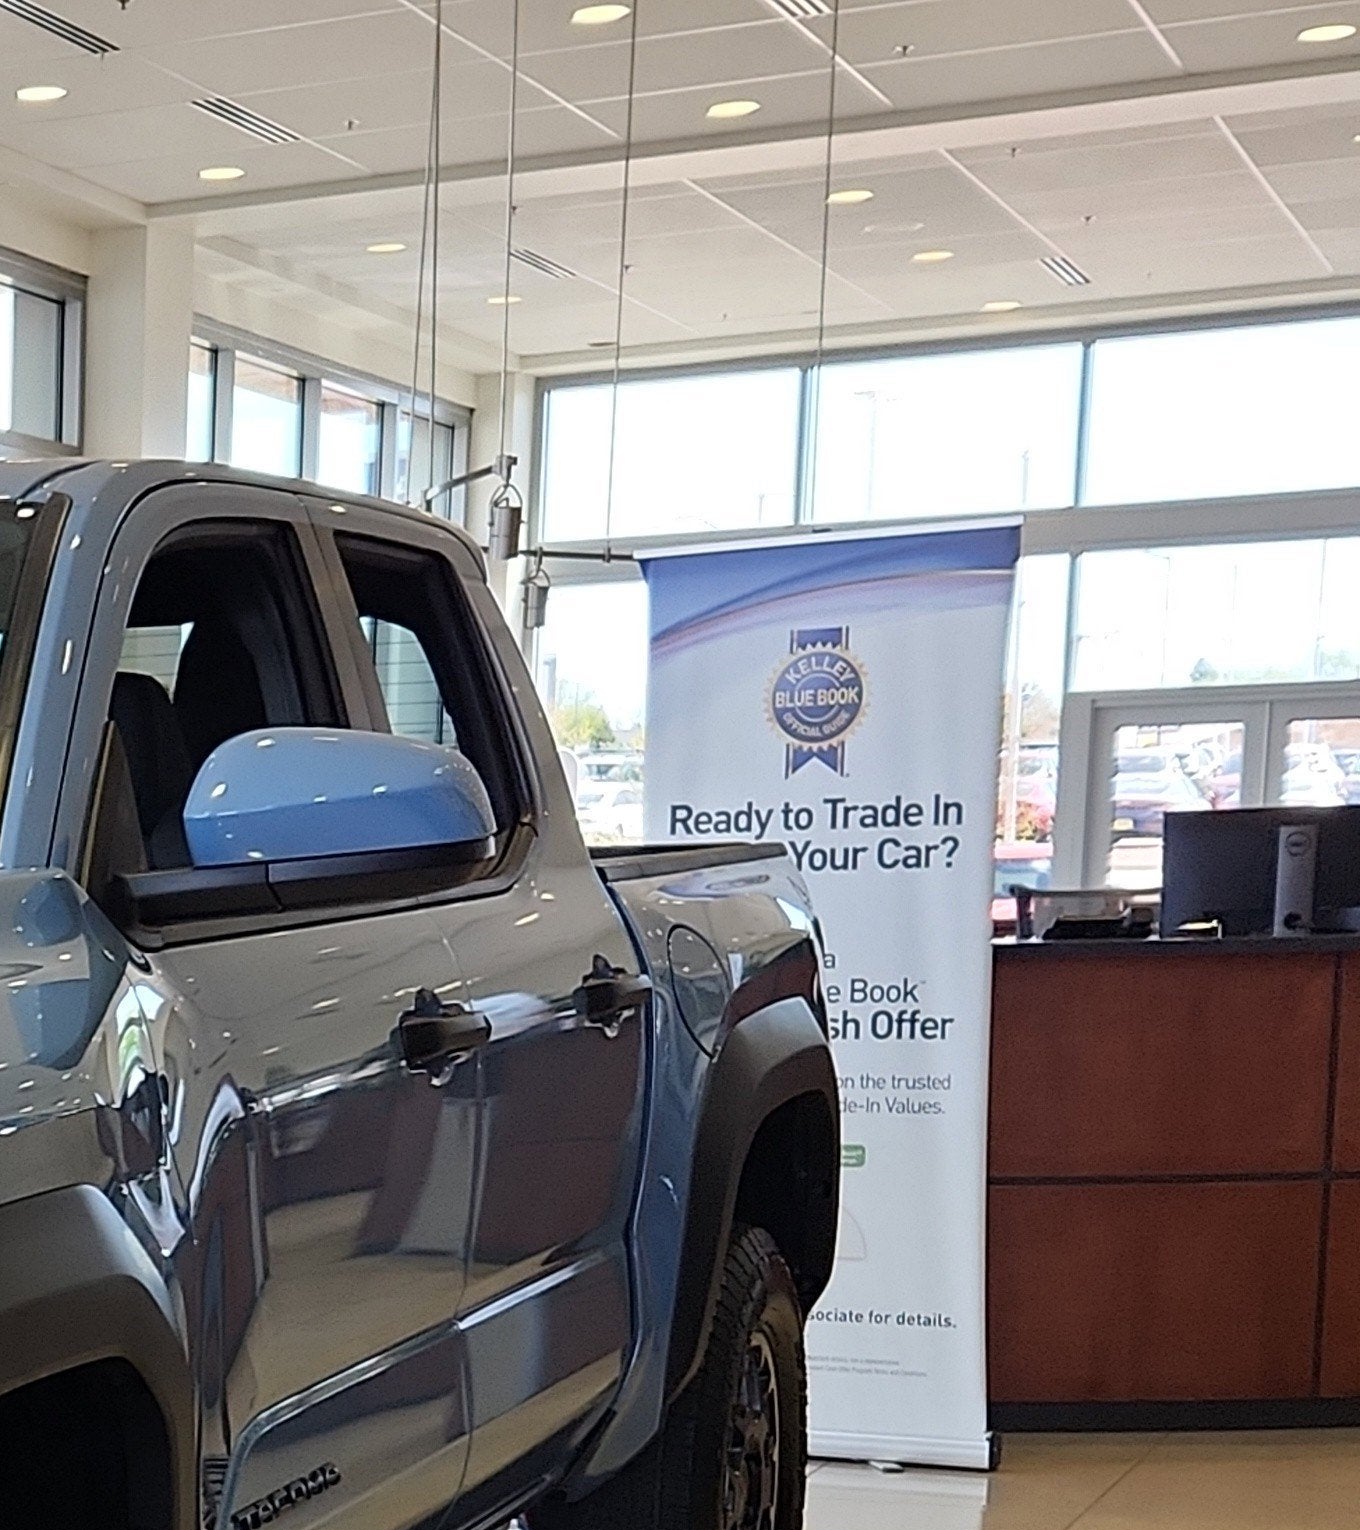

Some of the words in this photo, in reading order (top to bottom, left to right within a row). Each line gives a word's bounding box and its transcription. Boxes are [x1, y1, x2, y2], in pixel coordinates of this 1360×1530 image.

[785, 656, 856, 684] KELLEY
[775, 689, 817, 709] BLUE
[817, 686, 860, 706] BOOK
[670, 802, 773, 839] Ready
[782, 802, 813, 831] to
[823, 795, 924, 829] Trade
[933, 793, 963, 826] In
[788, 840, 869, 872] Your
[877, 836, 960, 870] Car?
[829, 1010, 861, 1040] sh
[871, 1010, 955, 1040] Offer
[860, 1073, 886, 1090] the
[891, 1074, 951, 1091] trusted
[840, 1096, 881, 1114] de-In
[885, 1096, 946, 1115] Values.
[808, 1308, 864, 1324] ociate
[869, 1310, 892, 1325] for
[896, 1311, 958, 1329] details.
